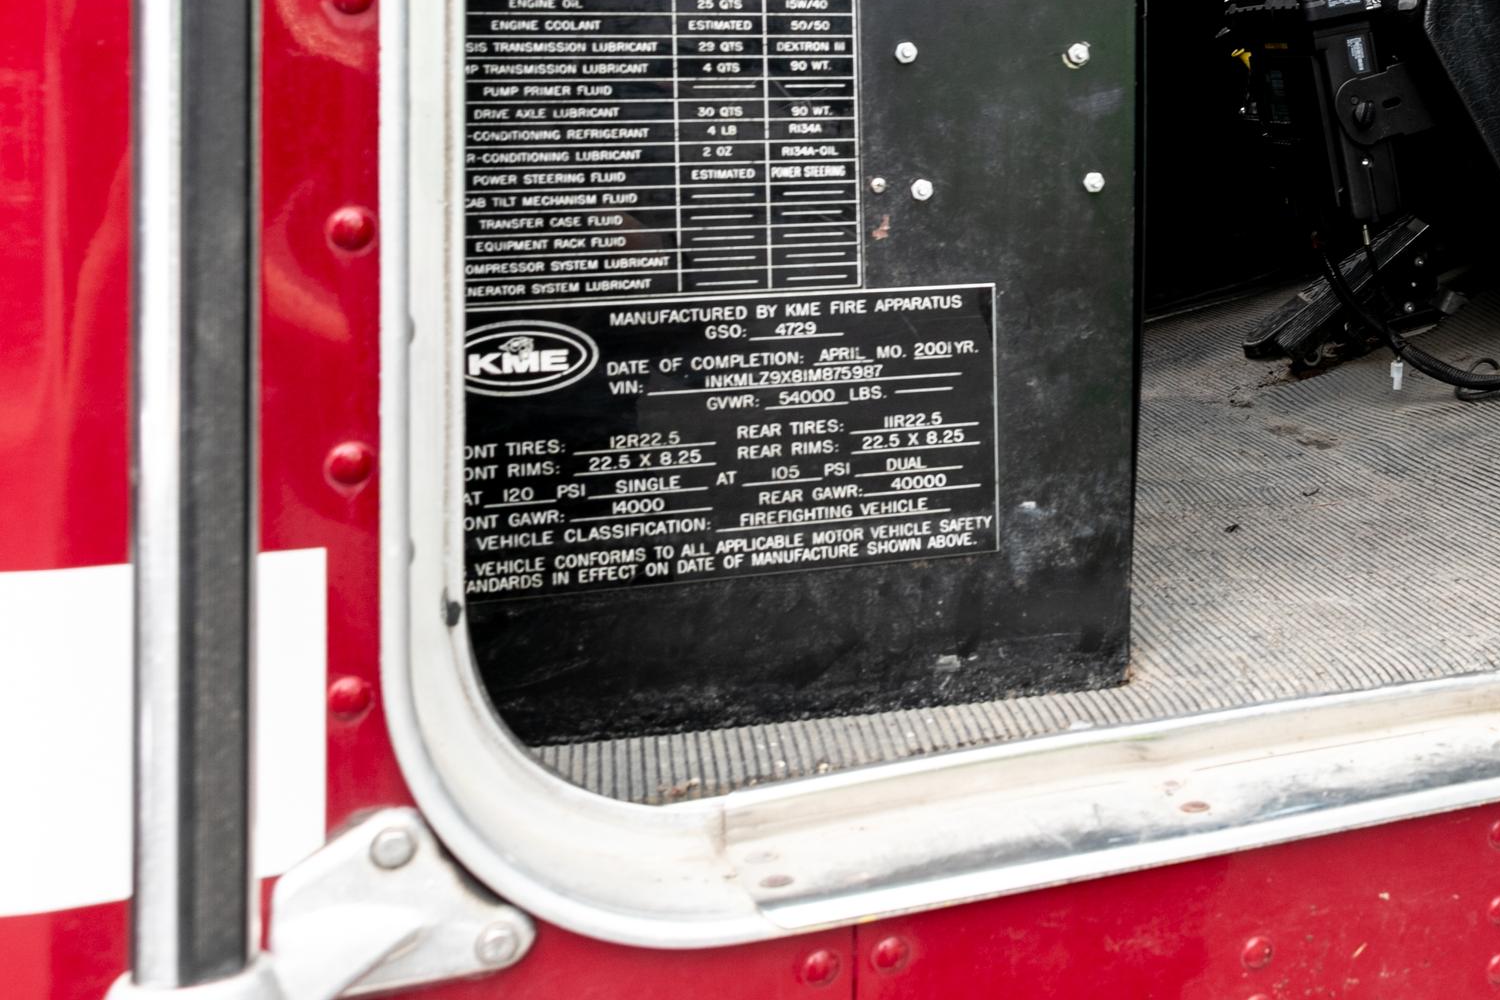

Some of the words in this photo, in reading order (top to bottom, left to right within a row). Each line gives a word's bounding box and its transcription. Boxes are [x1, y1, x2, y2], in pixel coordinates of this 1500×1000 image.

[785, 0, 828, 9] 15W/40
[491, 20, 539, 31] ENGINE
[544, 19, 602, 31] COOLANT
[688, 19, 752, 31] ESTIMATED
[790, 20, 830, 31] 50/50
[492, 42, 586, 53] TRANSMISSION
[592, 41, 659, 52] LUBRICANT
[720, 41, 744, 52] QTS
[776, 41, 829, 51] DEXTRON
[482, 63, 577, 75] TRANSMISSION
[582, 63, 649, 74] LUBRICANT
[702, 62, 712, 73] 4
[717, 62, 741, 73] QTS
[790, 60, 807, 71] 90
[811, 60, 832, 71] WT.
[483, 86, 519, 97] PUMP
[524, 85, 571, 97] PRIMER
[577, 85, 613, 96] FLUID
[474, 108, 510, 119] DRIVE
[515, 108, 547, 119] AXLE
[553, 107, 620, 118] LUBRICANT
[698, 106, 715, 117] 30
[719, 106, 743, 117] QTS
[791, 106, 808, 116] 90
[812, 105, 833, 116] WT.
[567, 128, 650, 139] REFRIGERANT
[706, 125, 717, 136] 4
[721, 125, 737, 136] LB
[788, 123, 822, 134] R134A
[575, 150, 642, 161] LUBRICANT
[702, 147, 712, 157] 2
[716, 146, 733, 157] OZ
[781, 145, 839, 156] R134A-OIL
[473, 174, 517, 186] POWER
[523, 173, 585, 185] STEERING
[591, 171, 626, 183] FLUID
[691, 168, 756, 180] ESTIMATED
[771, 166, 801, 178] POWER
[804, 165, 846, 177] STEERING
[492, 196, 517, 207] TILT
[522, 195, 597, 207] MECHANISM
[602, 193, 638, 204] FLUID
[479, 218, 544, 230] TRANSFER
[550, 216, 582, 228] CASE
[587, 215, 623, 226] FLUID
[475, 240, 549, 253] EQUIPMENT
[554, 238, 586, 249] RACK
[591, 237, 626, 248] FLUID
[550, 260, 598, 272] SYSTEM
[604, 256, 671, 269] LUBRICANT
[464, 284, 525, 297] NERATOR
[531, 282, 579, 295] SYSTEM
[585, 279, 652, 292] LUBRICANT
[609, 306, 748, 326] MANUFACTURED
[756, 304, 778, 319] BY
[785, 302, 821, 317] KME
[830, 299, 867, 315] FIRE
[874, 294, 963, 312] APPARATUS
[705, 324, 747, 339] GSO:
[774, 321, 817, 336] 4729
[468, 349, 569, 376] KME
[606, 359, 650, 376] DATE
[659, 356, 684, 373] OF
[690, 351, 804, 371] COMPLETION:
[818, 346, 866, 362] APRIL
[876, 345, 907, 359] MO.
[914, 341, 952, 356] 2001
[954, 339, 979, 354] YR.
[609, 380, 644, 395] VIN:
[707, 394, 760, 411] GVWR:
[779, 388, 835, 405] 54000
[849, 385, 887, 401] LBS.
[737, 423, 781, 439] REAR
[790, 419, 844, 435] TIRES:
[884, 411, 942, 428] 11R22.5
[505, 439, 566, 456] TIRES:
[610, 431, 680, 449] 12R22.5
[737, 443, 782, 460] REAR
[791, 439, 839, 456] RIMS:
[862, 434, 900, 450] 22.5
[908, 432, 919, 446] X
[926, 429, 965, 444] 8.25
[507, 461, 560, 478] RIMS:
[589, 454, 630, 472] 22.5
[639, 453, 651, 467] X
[659, 449, 702, 466] 8.25
[716, 470, 737, 486] AT
[771, 465, 800, 480] 105
[824, 462, 850, 477] PSI
[886, 456, 927, 472] DUAL
[503, 486, 534, 502] 120
[556, 483, 586, 499] PSI
[615, 475, 681, 494] SINGLE
[758, 488, 803, 505] REAR
[812, 484, 863, 500] GAWR:
[890, 473, 947, 490] 40000
[508, 509, 565, 527] GAWR:
[612, 498, 665, 515] 14000
[476, 530, 554, 551] VEHICLE
[564, 518, 711, 544] CLASSIFICATION:
[739, 504, 853, 527] FIREFIGHTING
[860, 497, 928, 516] VEHICLE
[475, 557, 546, 578] VEHICLE
[554, 547, 647, 570] CONFORMS
[654, 545, 674, 560] TO
[680, 541, 711, 558] ALL
[716, 533, 804, 556] APPLICABLE
[812, 527, 864, 545] MOTOR
[870, 521, 931, 539] VEHICLE
[939, 515, 993, 533] SAFETY
[464, 572, 543, 594] ANDARDS
[552, 570, 570, 586] IN
[578, 564, 639, 584] EFFECT
[645, 561, 669, 577] ON
[677, 557, 716, 575] DATE
[723, 553, 745, 570] OF
[751, 540, 859, 566] MANUFACTURE
[867, 535, 921, 555] SHOWN
[926, 532, 978, 549] ABOVE.
